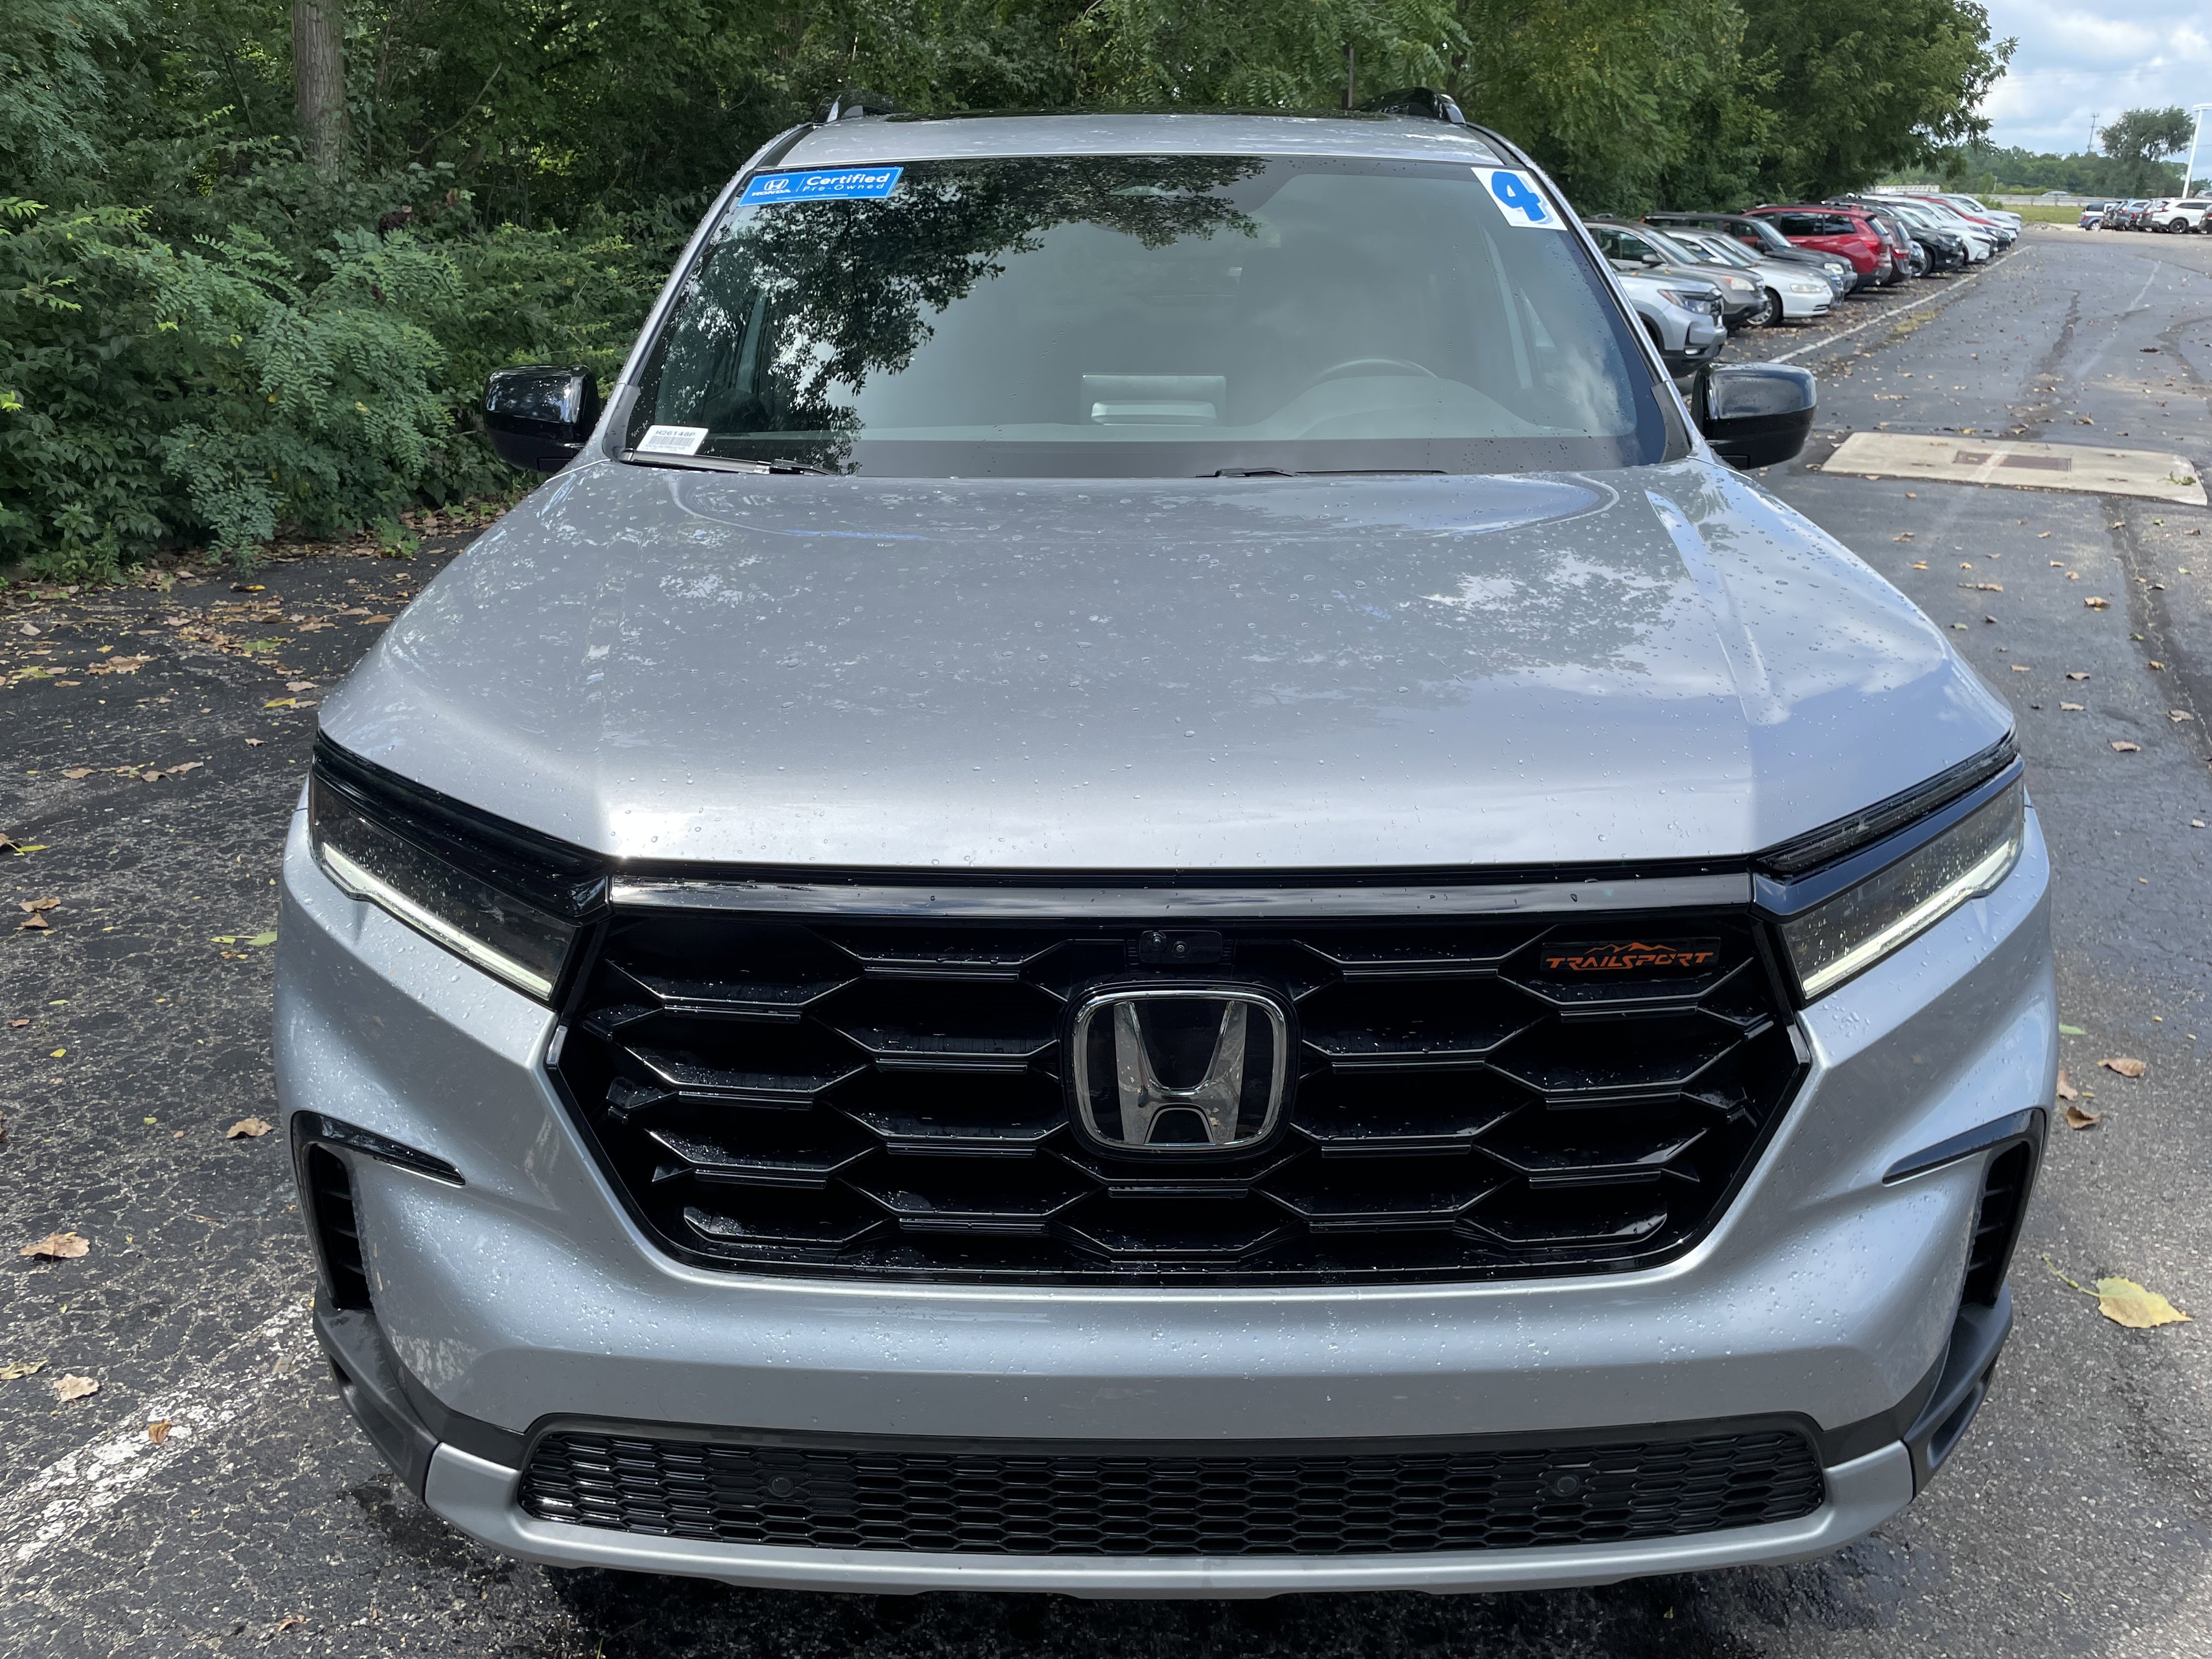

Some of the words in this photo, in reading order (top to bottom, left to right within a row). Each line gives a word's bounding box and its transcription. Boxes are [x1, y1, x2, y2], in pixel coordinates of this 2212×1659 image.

[806, 173, 890, 186] Certified
[751, 189, 792, 197] HONDA
[803, 183, 885, 193] Pre-Owned
[1491, 171, 1547, 222] 4
[1546, 952, 1714, 970] TRAILSPORT
